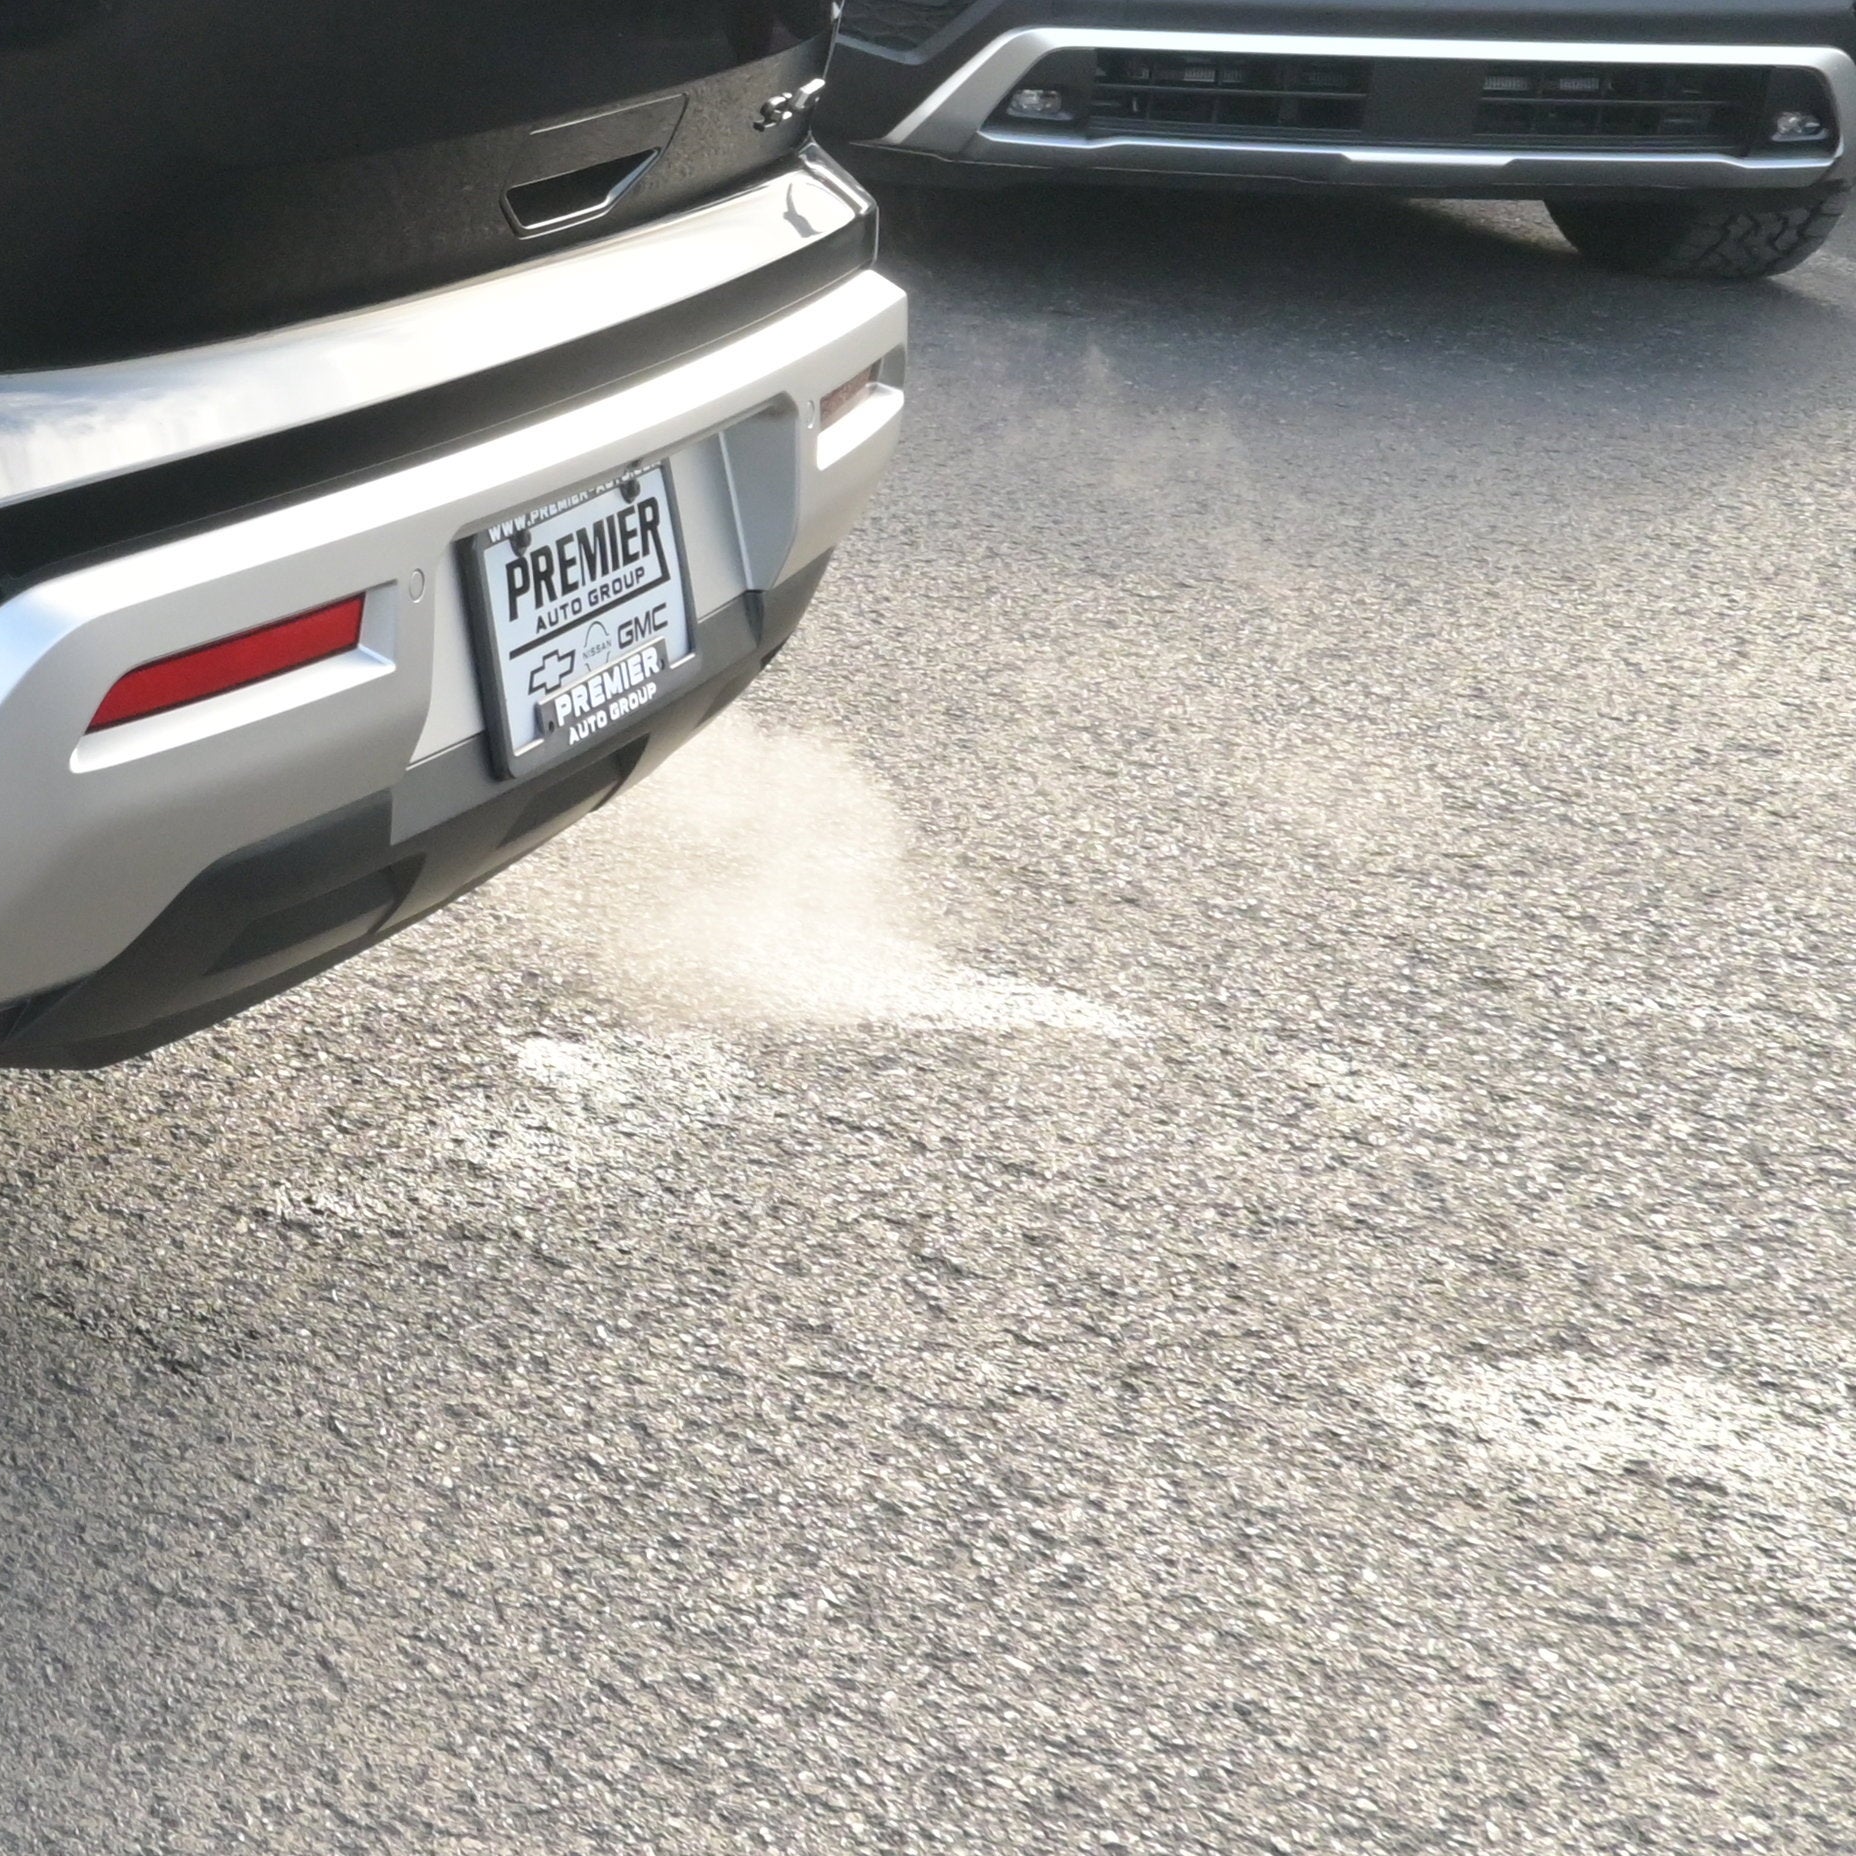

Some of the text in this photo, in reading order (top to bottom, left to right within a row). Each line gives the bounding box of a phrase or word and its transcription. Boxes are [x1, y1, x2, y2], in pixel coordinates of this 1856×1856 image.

[505, 496, 664, 622] PREMIER
[536, 566, 645, 634] AUTO GROUP
[582, 601, 669, 659] NISSAN GMC
[555, 646, 660, 727] PREMIER
[569, 682, 657, 745] AUTO GROUP
